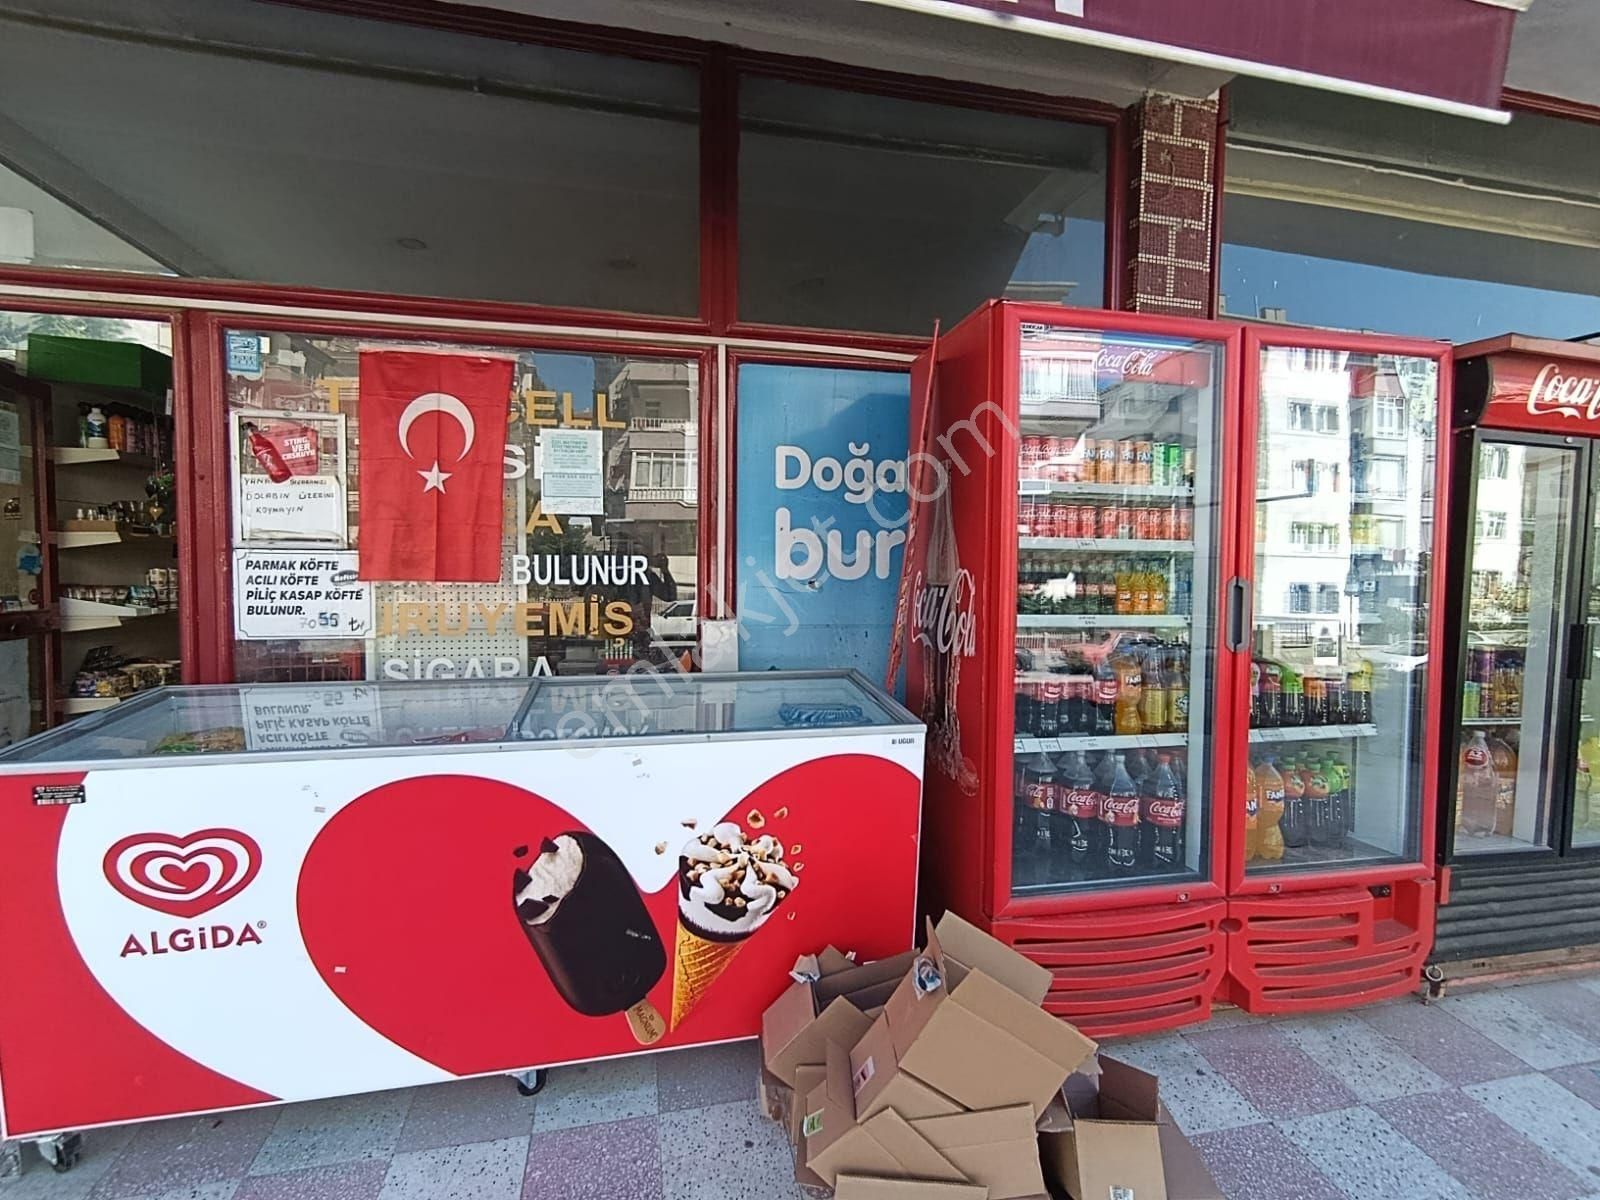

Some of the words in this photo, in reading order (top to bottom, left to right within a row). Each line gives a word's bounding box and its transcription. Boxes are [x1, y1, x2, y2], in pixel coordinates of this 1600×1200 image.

[1092, 347, 1158, 377] Coca-Cola
[775, 442, 909, 503] Doğa
[245, 560, 296, 571] PARMAK
[299, 558, 339, 571] KÖFTE
[512, 554, 649, 586] BULUNUR
[246, 575, 277, 586] ACILI
[279, 573, 319, 586] KÖFTE
[246, 587, 277, 604] PİLİÇ
[279, 590, 322, 601] KASAP
[324, 588, 364, 601] KÖFTE
[246, 605, 306, 617] BULUNUR.
[912, 567, 977, 657] Coca-Cola
